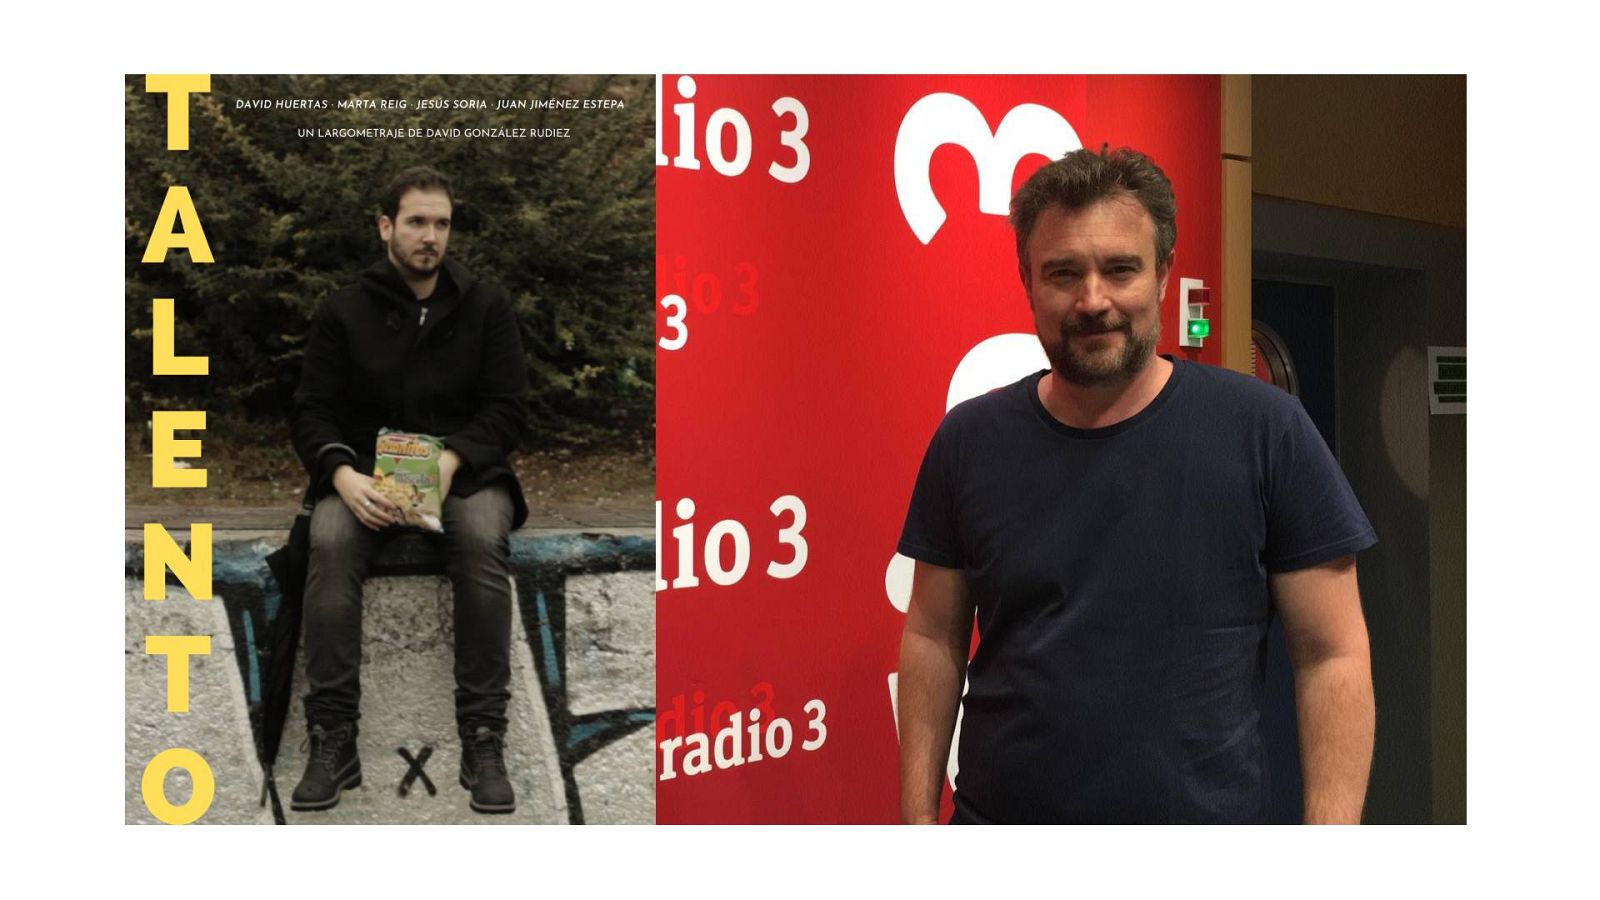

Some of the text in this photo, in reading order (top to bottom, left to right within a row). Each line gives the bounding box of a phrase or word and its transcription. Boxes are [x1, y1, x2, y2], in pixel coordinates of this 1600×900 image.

[768, 96, 811, 184] 3
[658, 294, 689, 351] 3
[732, 260, 760, 316] 3
[766, 494, 809, 579] 3
[659, 698, 828, 781] radio 3
